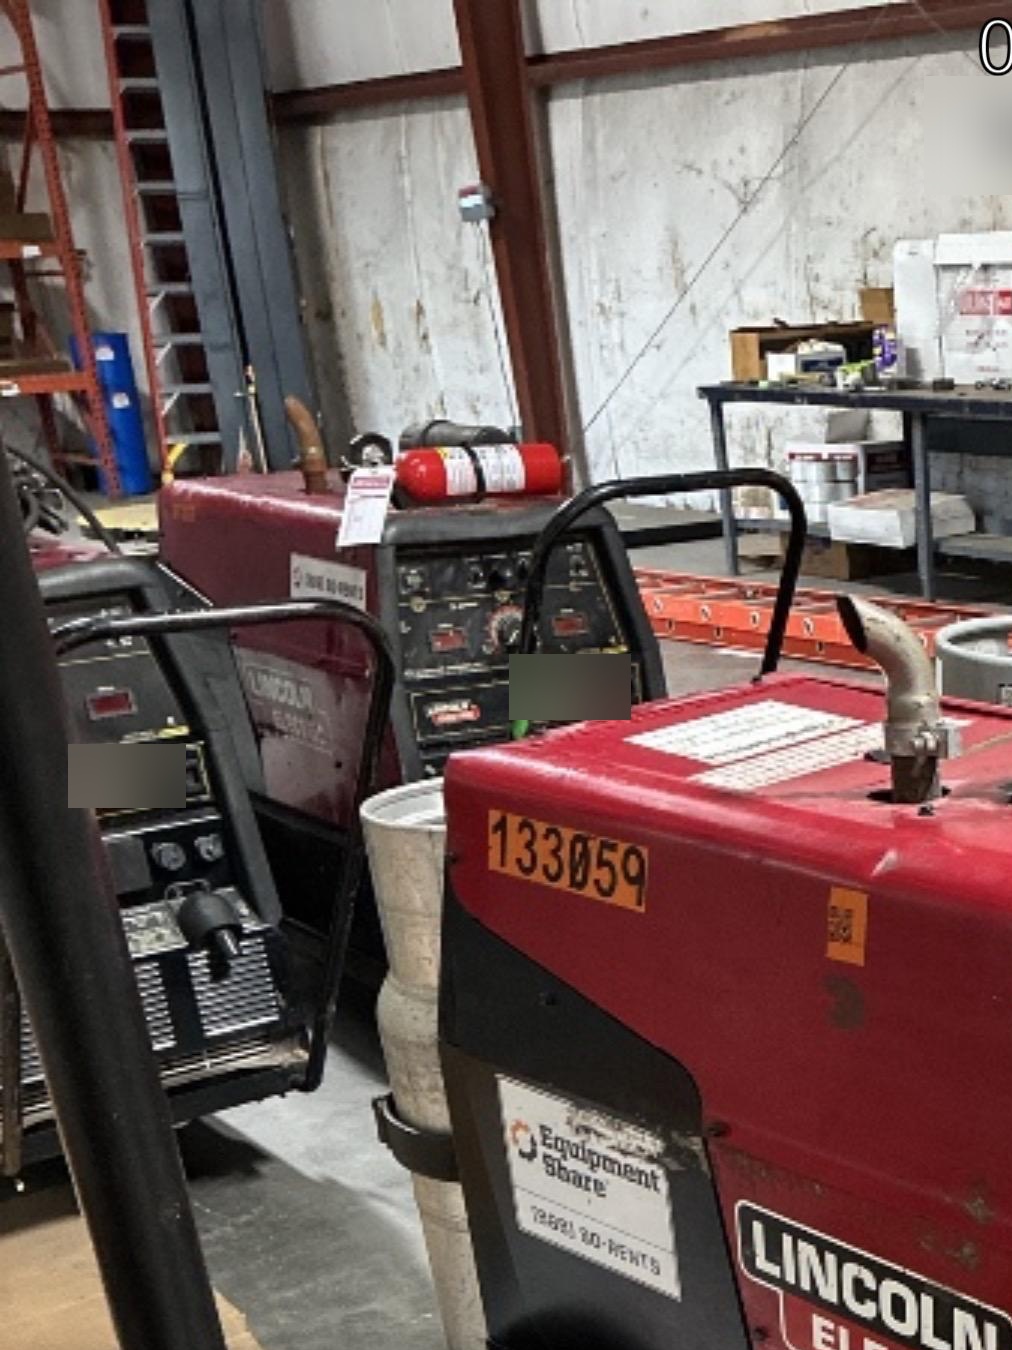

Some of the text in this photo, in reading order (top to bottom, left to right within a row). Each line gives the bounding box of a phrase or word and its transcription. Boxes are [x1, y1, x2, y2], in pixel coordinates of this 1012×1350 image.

[492, 815, 646, 907] 133059
[540, 1124, 661, 1194] Equipment
[542, 1153, 607, 1197] Share
